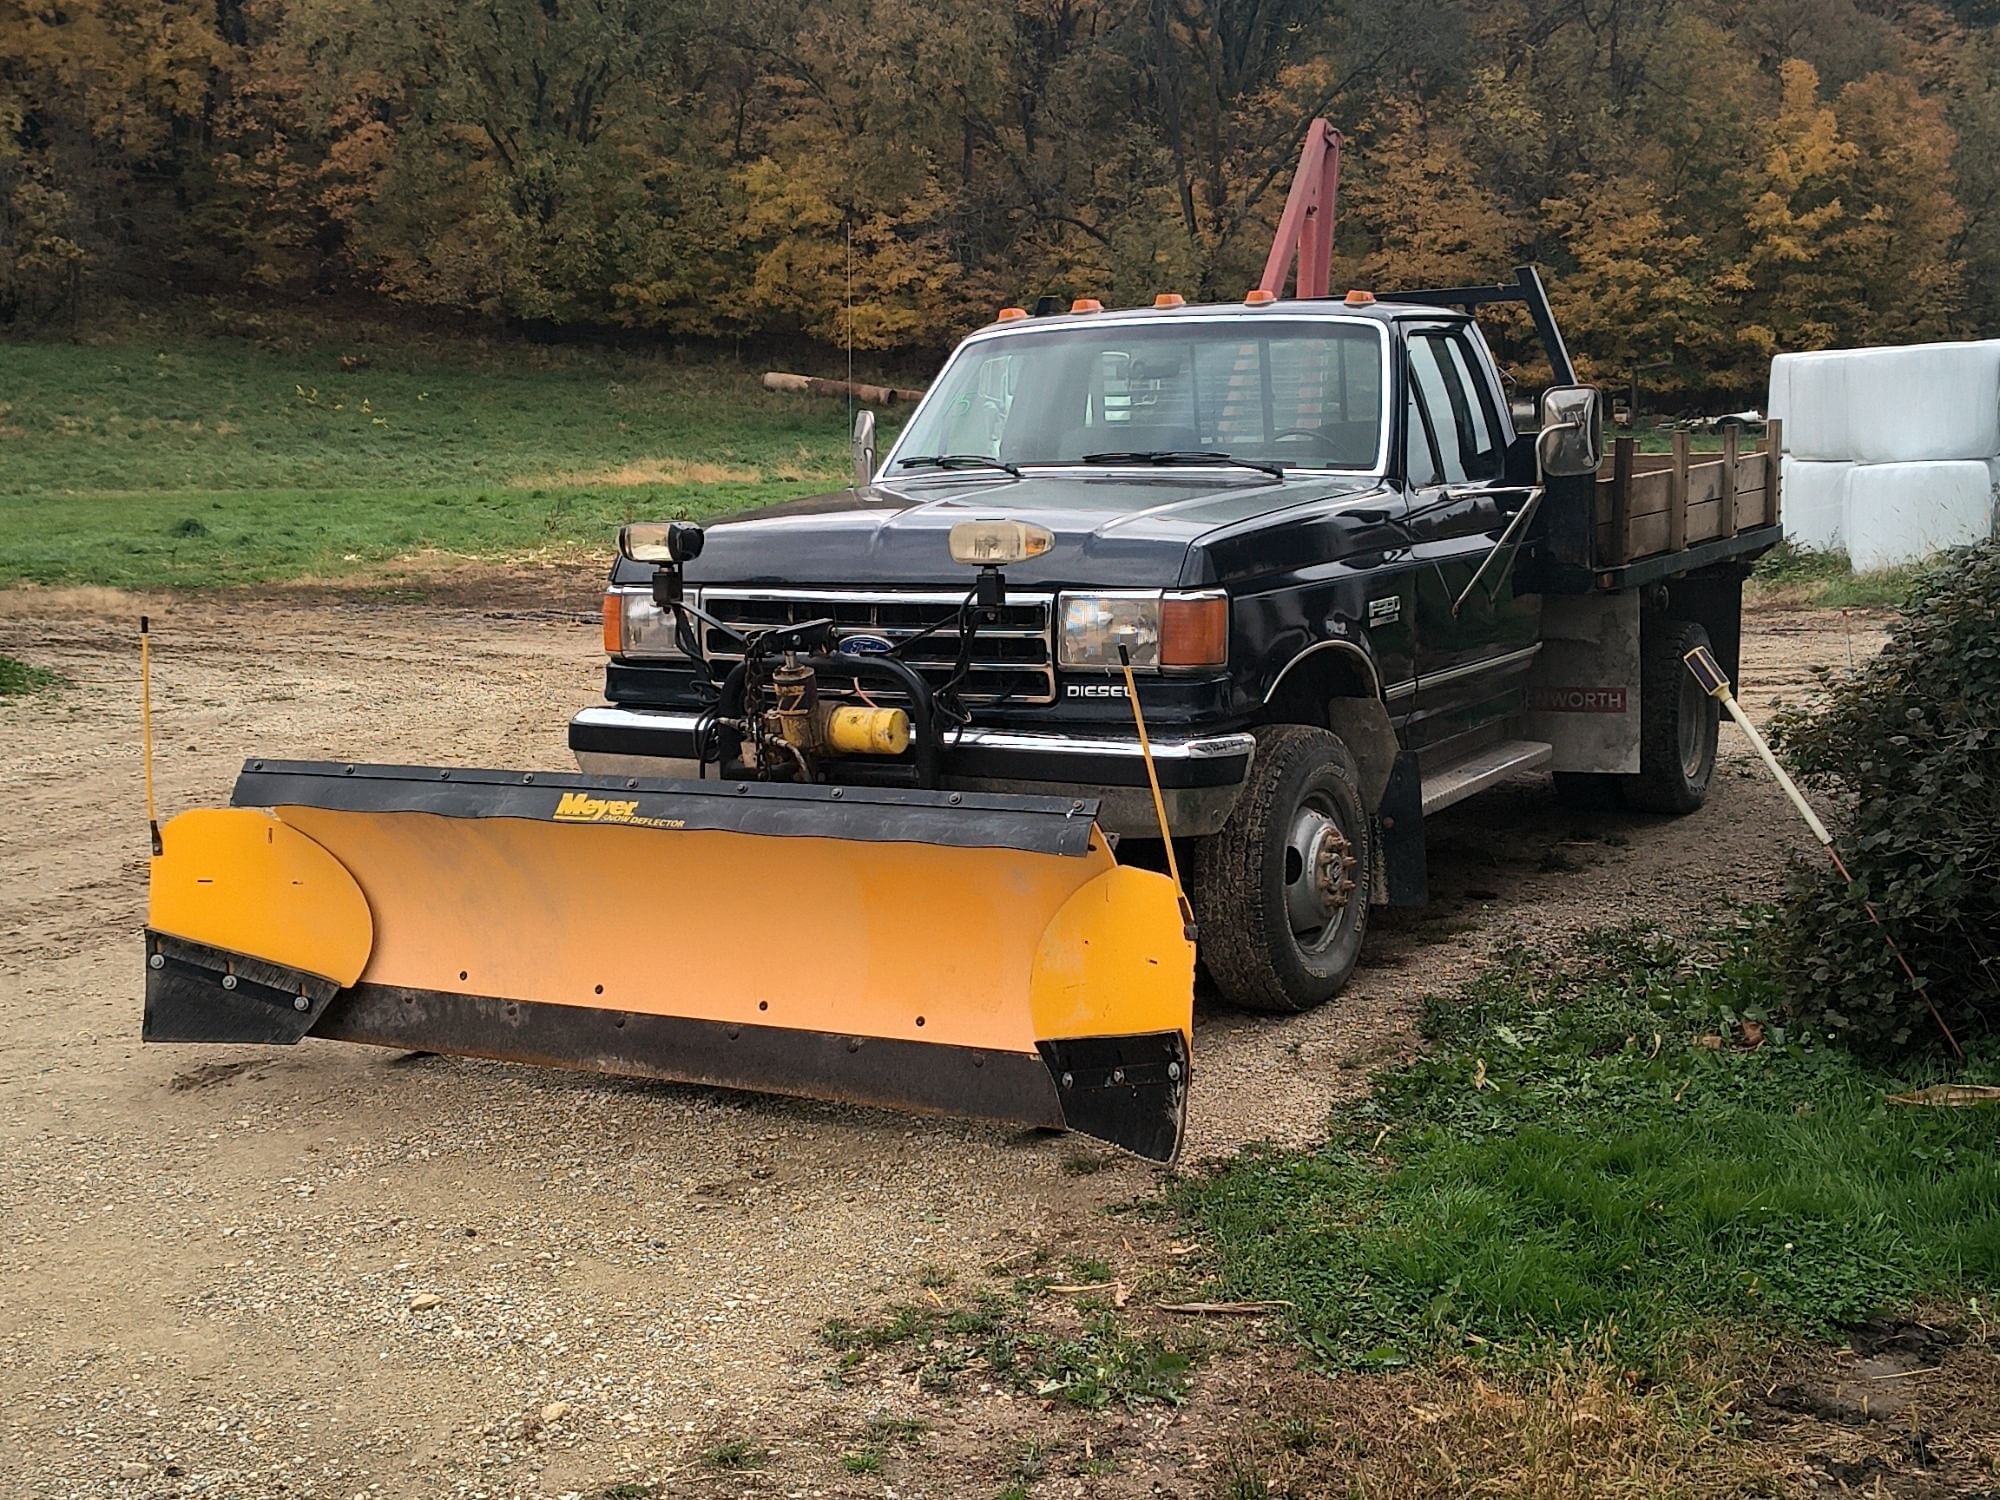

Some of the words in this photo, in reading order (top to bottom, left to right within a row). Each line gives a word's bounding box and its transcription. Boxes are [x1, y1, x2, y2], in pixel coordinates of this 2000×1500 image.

[1067, 685, 1132, 697] DIESEL
[553, 792, 639, 820] Meyer
[602, 814, 631, 824] SNOW
[631, 816, 686, 828] DEFLECTOR
